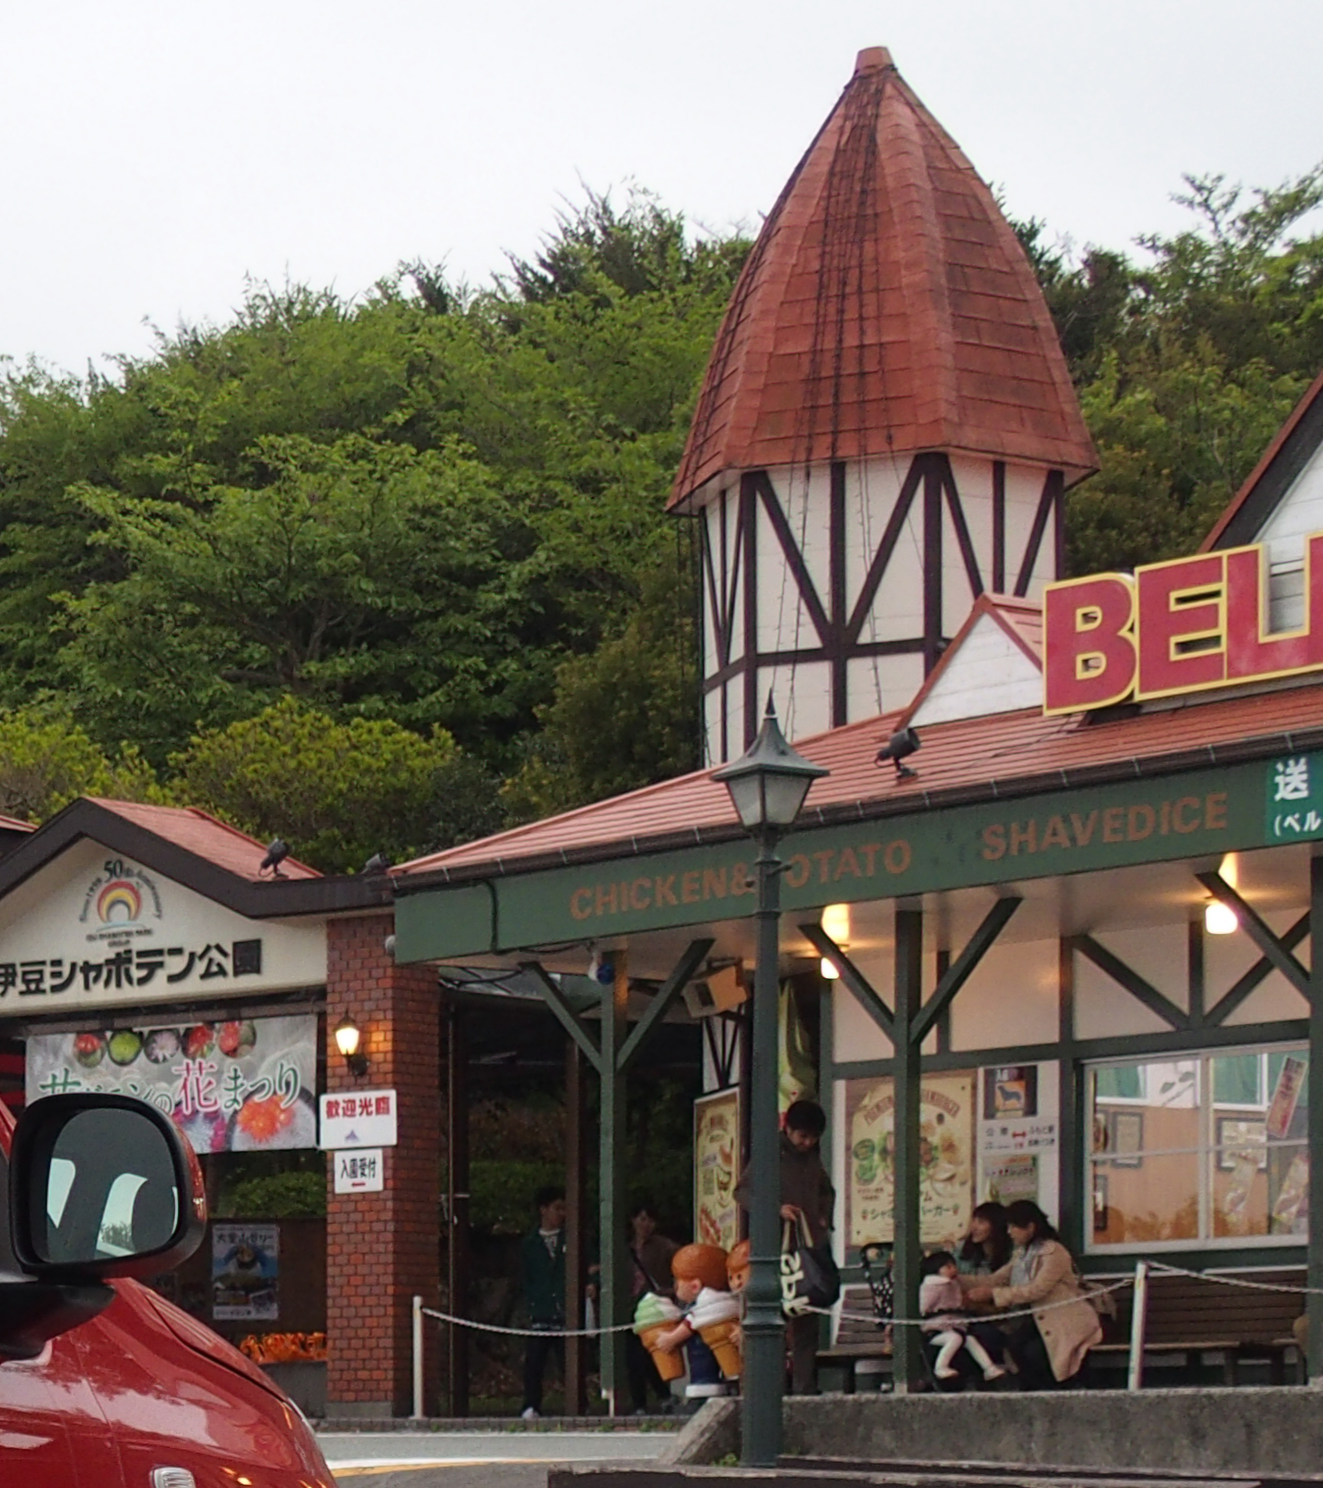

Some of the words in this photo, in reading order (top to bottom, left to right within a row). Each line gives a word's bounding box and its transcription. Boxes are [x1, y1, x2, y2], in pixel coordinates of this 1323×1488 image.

[1042, 532, 1323, 717] BEL
[784, 839, 912, 890] OTATO
[341, 1157, 377, 1179] 入園受付
